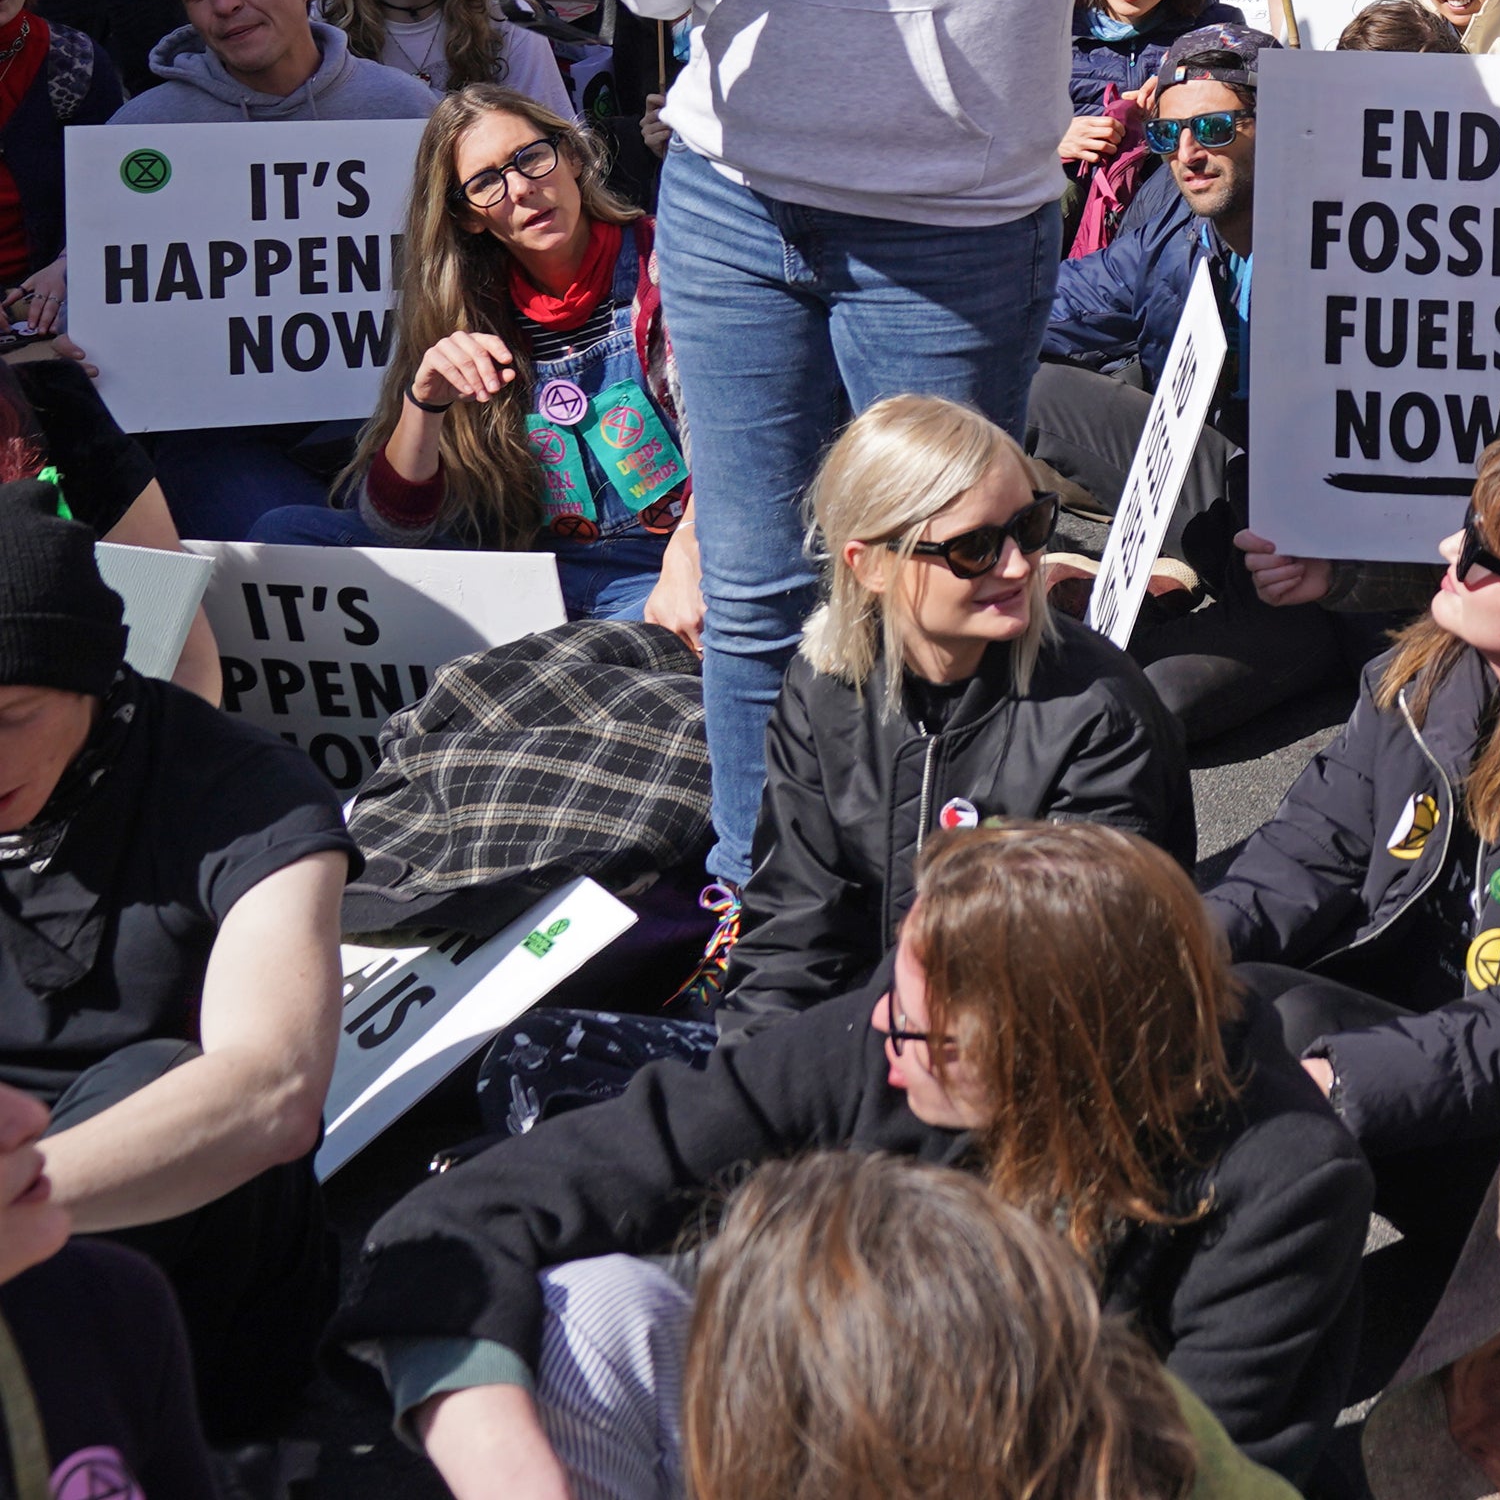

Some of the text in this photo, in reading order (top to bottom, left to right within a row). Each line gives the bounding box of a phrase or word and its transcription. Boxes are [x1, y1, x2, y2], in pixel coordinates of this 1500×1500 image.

[250, 159, 371, 222] IT'S
[228, 309, 394, 377] NOW
[1172, 329, 1198, 420] END
[615, 436, 665, 477] DEEDS
[628, 458, 680, 500] WORDS
[1144, 395, 1175, 520] FOSSIL
[241, 581, 382, 648] IT'S
